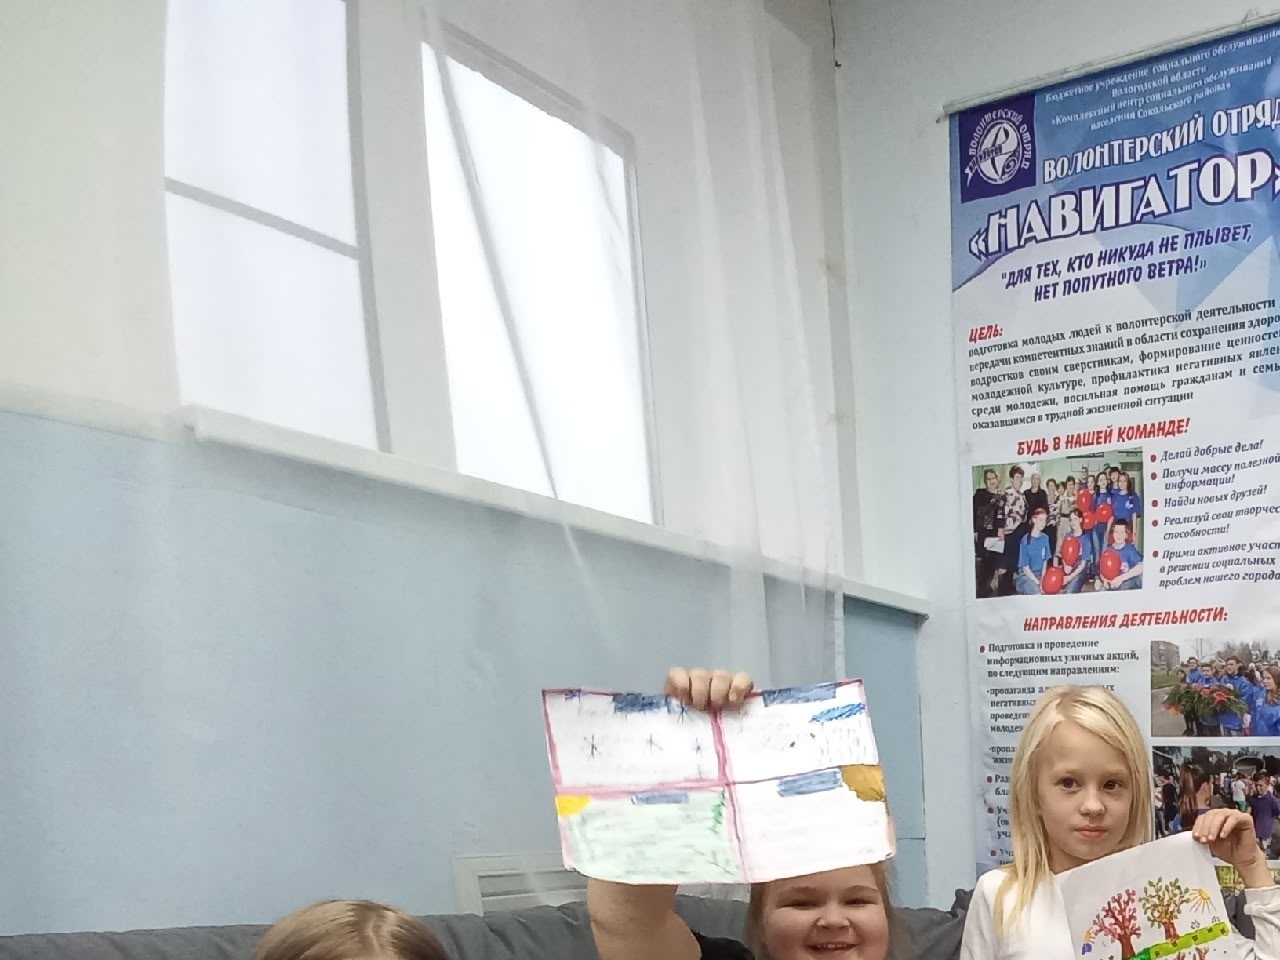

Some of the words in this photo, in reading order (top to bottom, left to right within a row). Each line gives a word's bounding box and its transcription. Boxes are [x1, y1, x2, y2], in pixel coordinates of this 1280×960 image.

[1043, 114, 1205, 184] ВОЛОНТЕРСКИЙ
[1036, 260, 1061, 281] ТЕХ,
[1066, 253, 1094, 274] КТО
[1098, 241, 1154, 267] НИКУДА
[1159, 234, 1179, 254] НЕ
[1184, 223, 1252, 248] ПЛЫВЕТ,
[1034, 281, 1059, 302] НЕТ
[1062, 266, 1142, 296] ПОПУТНОГО
[968, 340, 1018, 357] подготовка
[1022, 332, 1066, 347] молодых
[1069, 324, 1102, 339] людей
[1105, 324, 1112, 334] к
[1116, 309, 1192, 331] волонтерской
[1196, 299, 1276, 320] деятельности
[969, 324, 1004, 343] ЦЕЛЬ:
[969, 357, 1012, 373] передачи
[1013, 345, 1086, 365] компетентных
[1086, 337, 1124, 352] знаний
[1126, 337, 1133, 347] в
[1135, 331, 1178, 345] области
[1180, 319, 1246, 339] сохранения
[970, 371, 1025, 388] подростков
[1029, 365, 1059, 377] своим
[1064, 353, 1134, 373] сверстникам,
[1139, 340, 1222, 363] формирование
[971, 383, 1033, 402] молодежной
[1038, 377, 1086, 394] культуре,
[1091, 364, 1170, 386] профилактика
[1175, 352, 1243, 372] негативных
[971, 404, 1001, 417] среди
[1006, 397, 1058, 411] молодежи,
[1064, 387, 1118, 404] посильная
[1123, 382, 1166, 395] помощь
[1172, 369, 1232, 388] гражданам
[1239, 367, 1246, 376] и
[972, 415, 1036, 430] оказавшимся
[1038, 414, 1043, 422] в
[1045, 407, 1085, 424] трудной
[1086, 396, 1143, 415] жизненной
[1145, 391, 1194, 407] ситуации
[1016, 436, 1049, 457] БУДЬ
[1052, 435, 1061, 449] В
[1064, 424, 1113, 449] НАШЕЙ
[1117, 417, 1191, 443] КОМАНДЕ!
[1160, 448, 1192, 463] Делай
[1194, 444, 1233, 460] добрые
[1234, 440, 1265, 454] дела!
[1162, 465, 1200, 480] Получи
[1202, 462, 1232, 477] массу
[1164, 474, 1236, 492] информации!
[1164, 496, 1195, 508] Найди
[1197, 493, 1229, 505] новых
[1230, 485, 1267, 501] друзей!
[1163, 512, 1209, 526] Реализуй
[1211, 510, 1233, 520] свои
[1163, 523, 1230, 540] способности!
[1162, 548, 1195, 561] Прими
[1197, 543, 1247, 556] активное
[1160, 565, 1166, 573] в
[1167, 562, 1210, 575] решении
[1212, 557, 1276, 569] социальных
[1159, 576, 1201, 589] проблем
[1203, 573, 1240, 584] нашего
[1023, 614, 1117, 631] НАПРАВЛЕНИЯ
[1118, 607, 1229, 629] ДЕЯТЕЛЬНОСТИ:
[987, 654, 1063, 666] информационных
[1063, 652, 1105, 664] уличных
[1107, 650, 1140, 661] акций,
[988, 642, 1035, 655] Подготовка
[1044, 640, 1099, 651] проведение
[988, 670, 998, 678] по
[998, 667, 1049, 679] следующим
[1050, 665, 1120, 677] направлениям:
